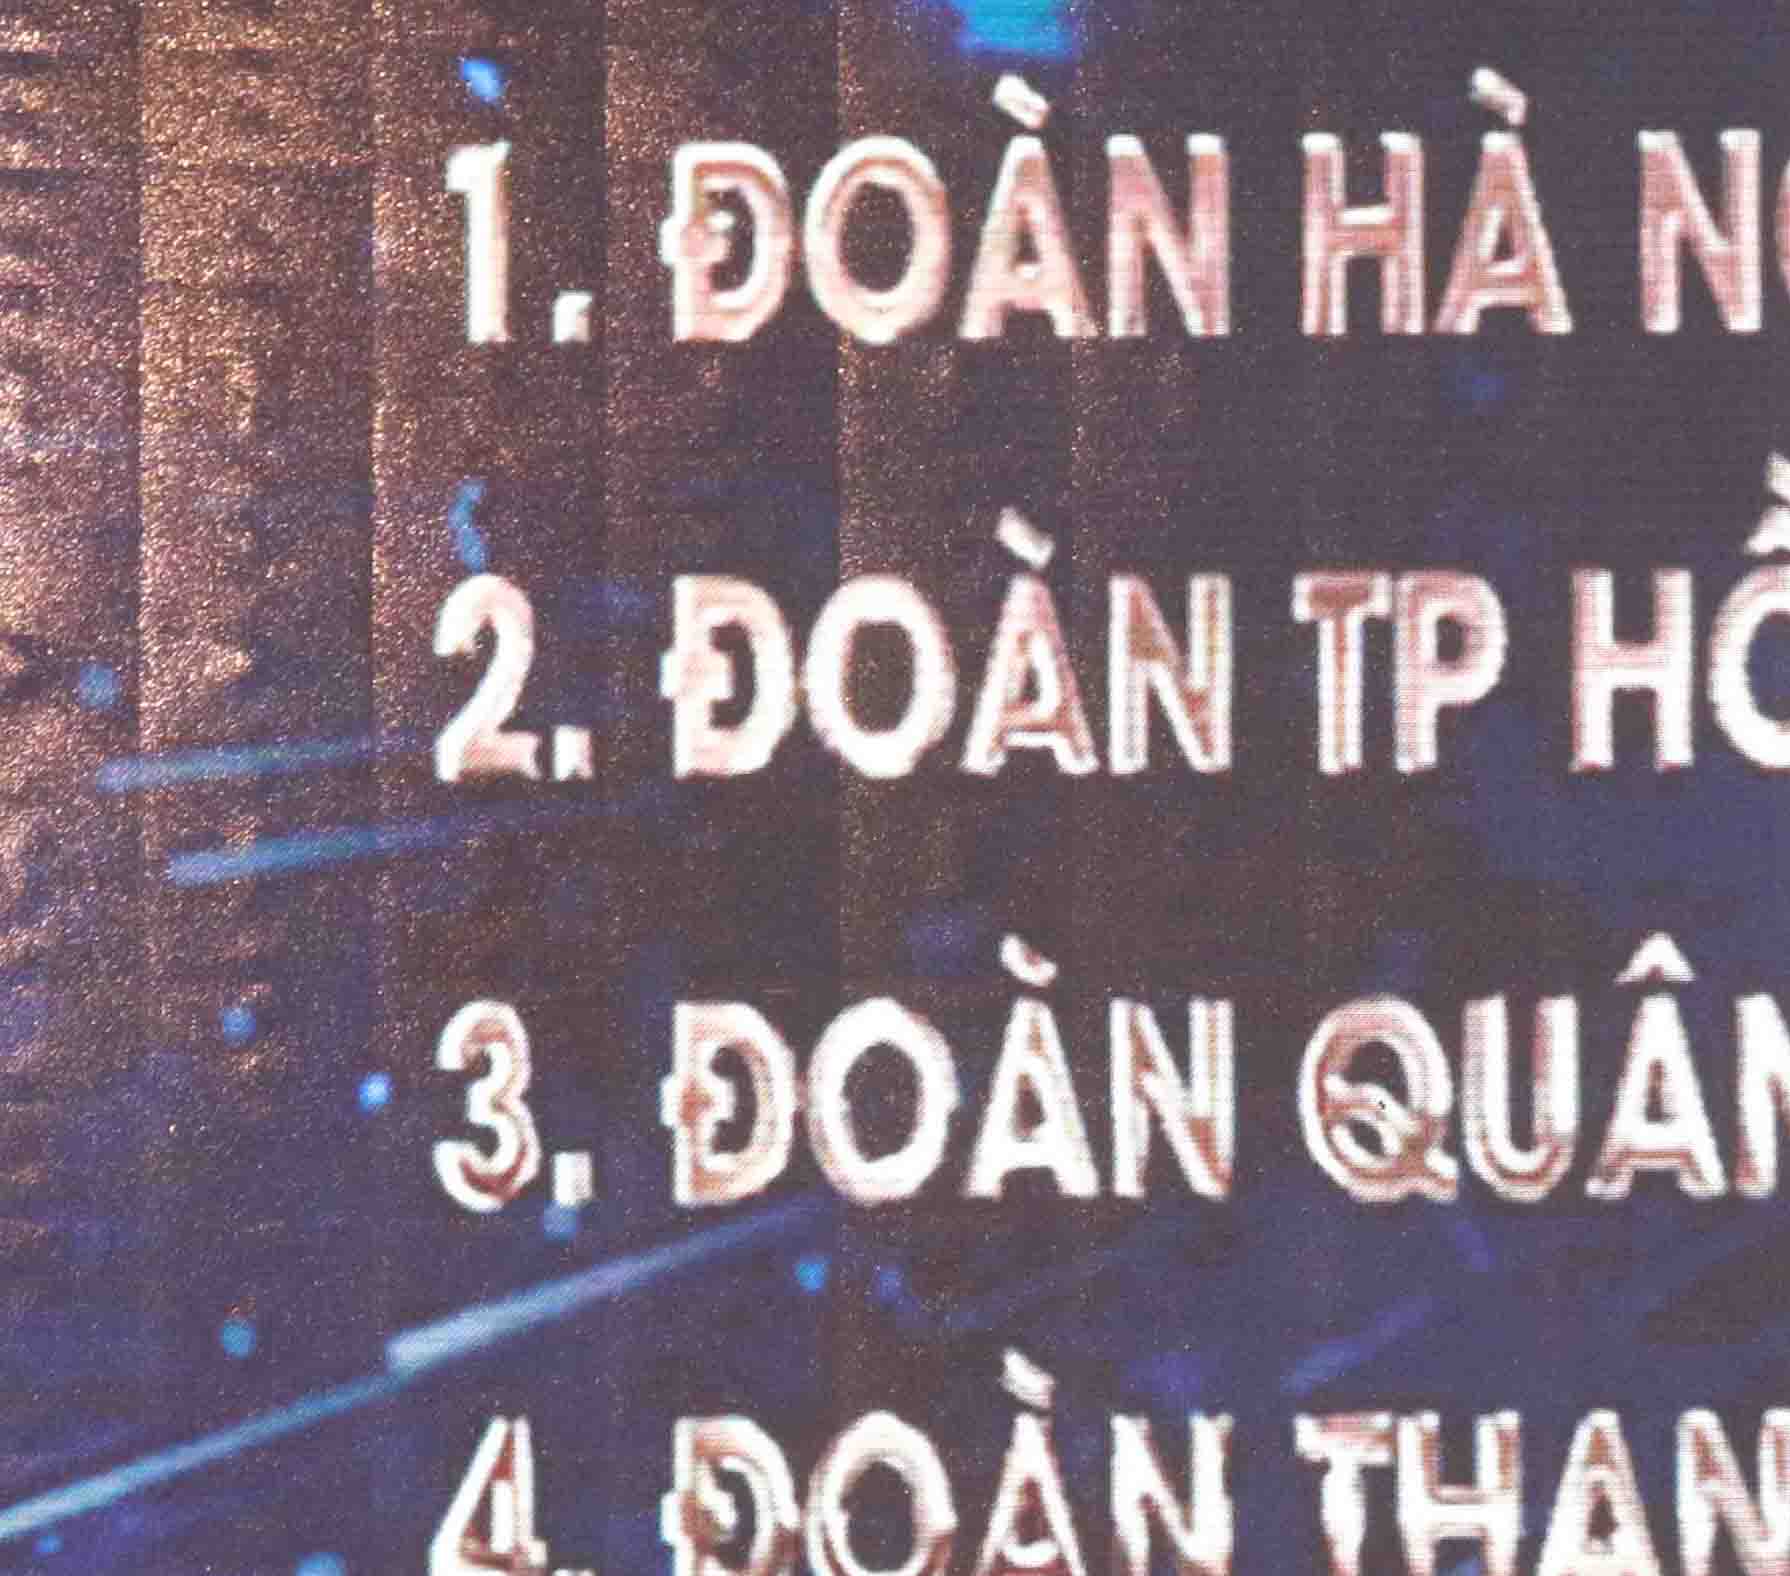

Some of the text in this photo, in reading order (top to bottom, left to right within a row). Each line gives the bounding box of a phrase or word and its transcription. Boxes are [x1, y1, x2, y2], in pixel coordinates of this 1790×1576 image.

[447, 140, 591, 344] 1.
[659, 72, 1229, 346] ĐOÀN
[1300, 68, 1574, 336] HÀ
[432, 573, 594, 781] 2.
[659, 508, 1234, 779] ĐOÀN
[1292, 570, 1506, 773] TP
[433, 1001, 592, 1212] 3.
[662, 940, 1234, 1208] ĐOÀN
